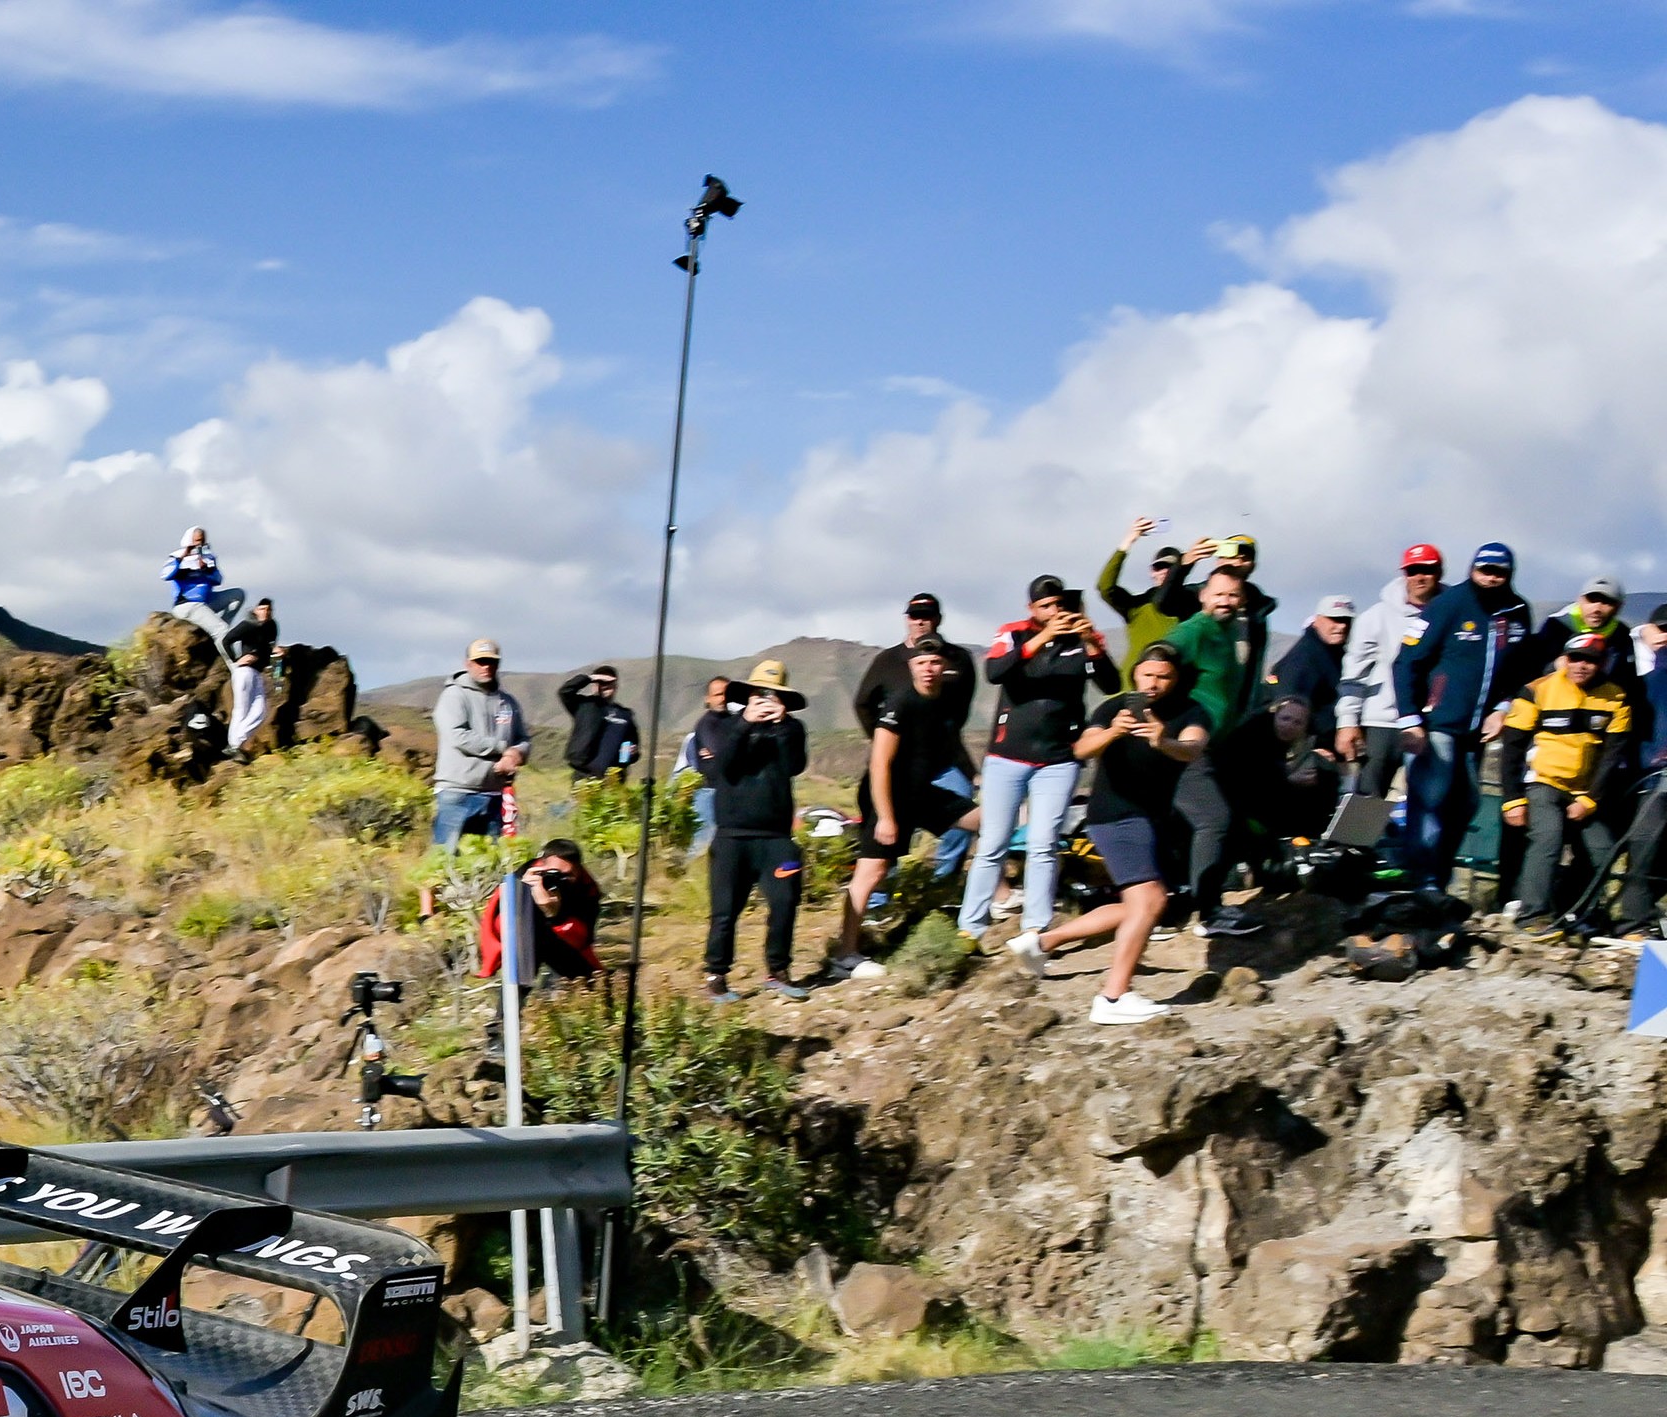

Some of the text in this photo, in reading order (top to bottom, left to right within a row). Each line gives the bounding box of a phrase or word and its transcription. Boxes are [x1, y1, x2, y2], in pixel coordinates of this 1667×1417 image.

[17, 1183, 141, 1220] YOU
[134, 1209, 371, 1281] WNGS.
[382, 1296, 435, 1308] RACING
[127, 1304, 181, 1331] Stilo
[19, 1324, 56, 1335] JAPAN
[28, 1335, 80, 1348] AIRLINES
